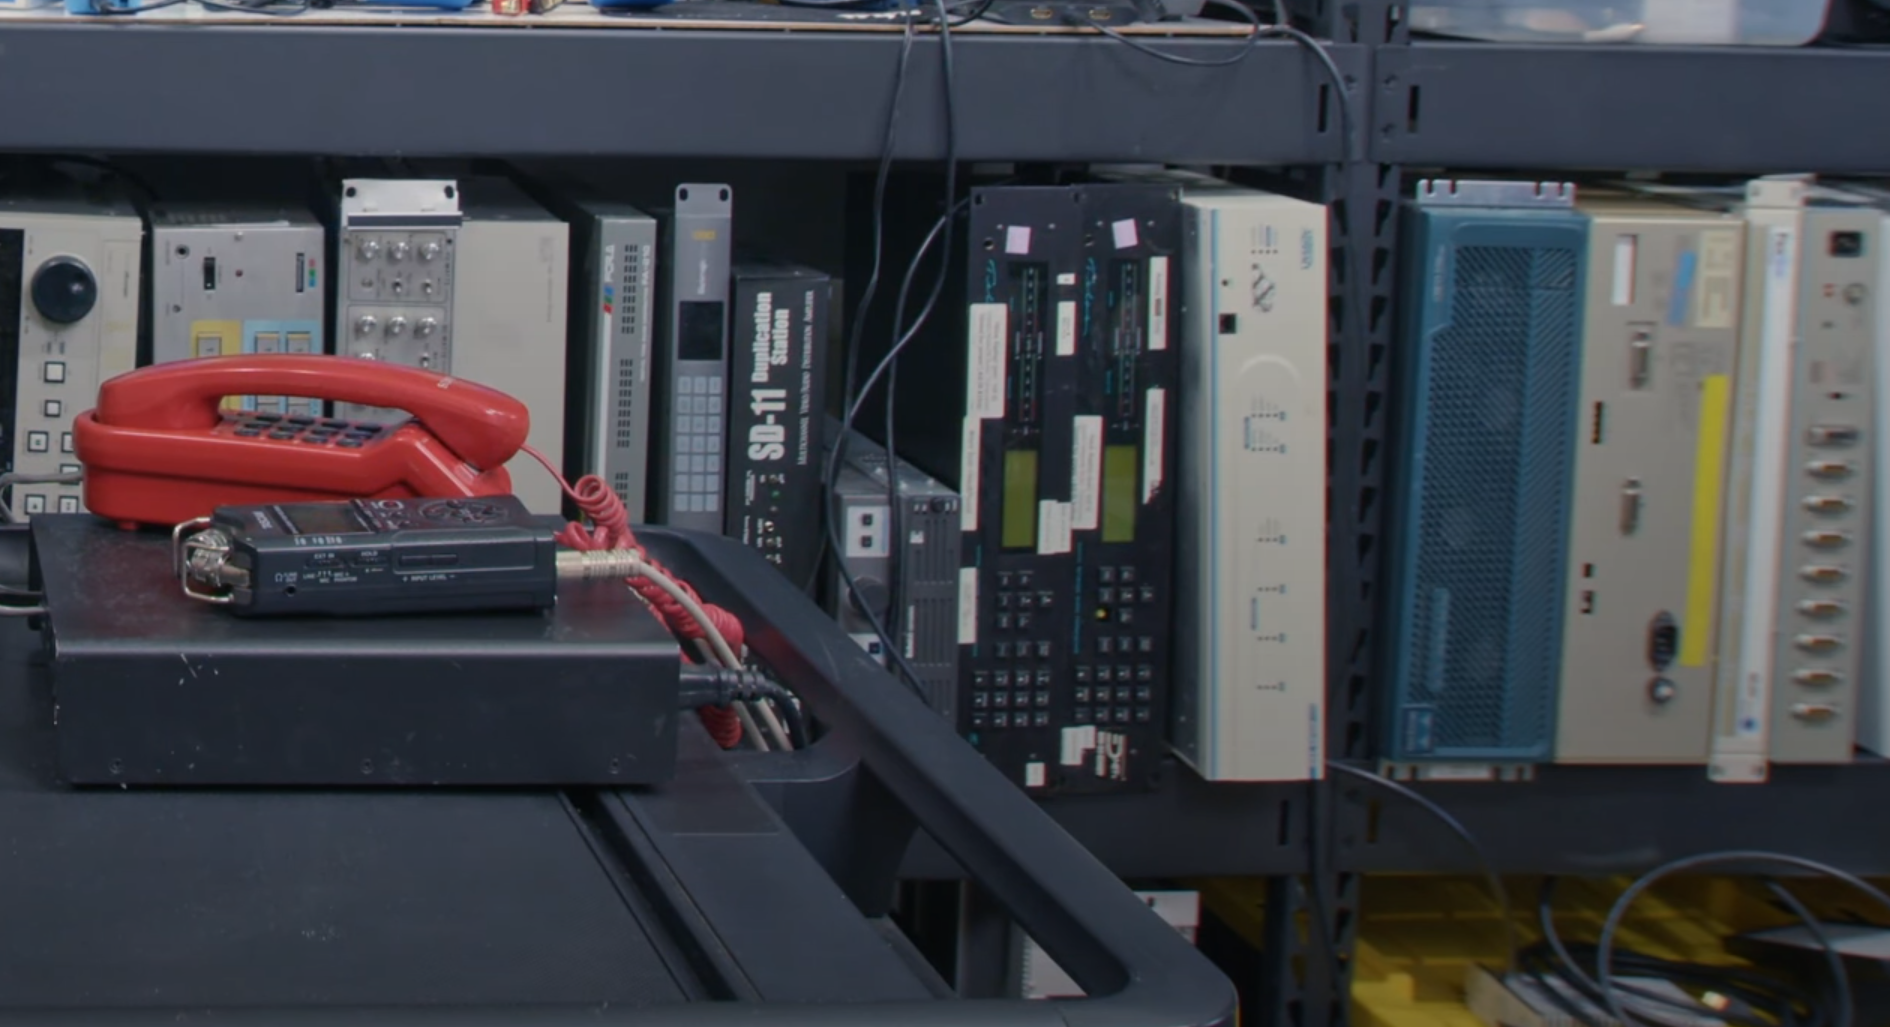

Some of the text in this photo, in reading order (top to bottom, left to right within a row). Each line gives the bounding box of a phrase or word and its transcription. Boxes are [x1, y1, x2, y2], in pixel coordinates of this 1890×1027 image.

[747, 292, 789, 461] SD-11 Duplication
[770, 308, 790, 366] Station
